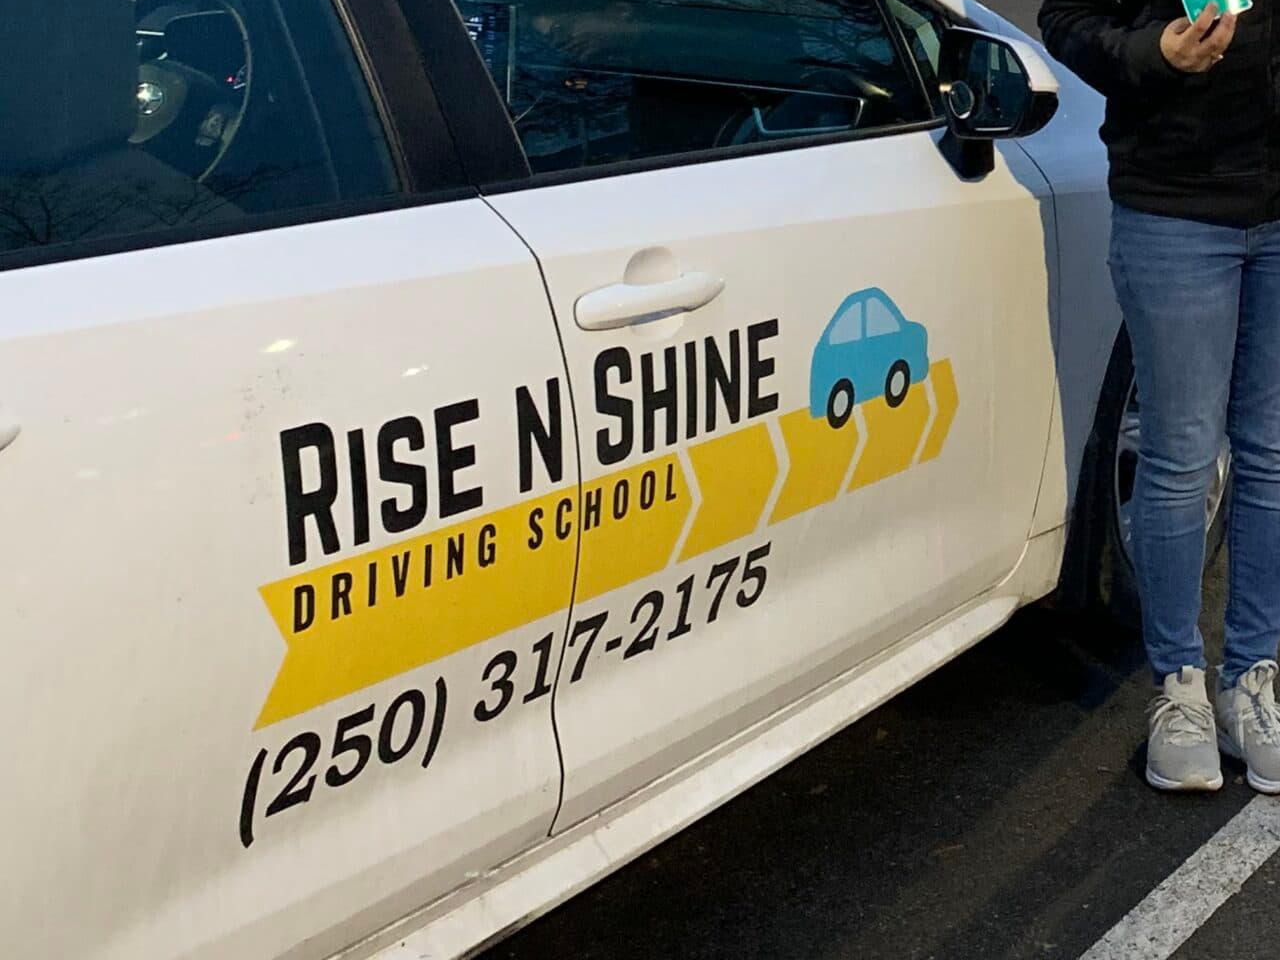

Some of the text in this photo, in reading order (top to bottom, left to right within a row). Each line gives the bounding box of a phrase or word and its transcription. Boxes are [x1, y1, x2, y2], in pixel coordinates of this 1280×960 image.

[280, 319, 780, 567] RISE N SHINE
[293, 463, 678, 633] DRIVING SCHOOL
[239, 541, 772, 848] (250) 317-2175
